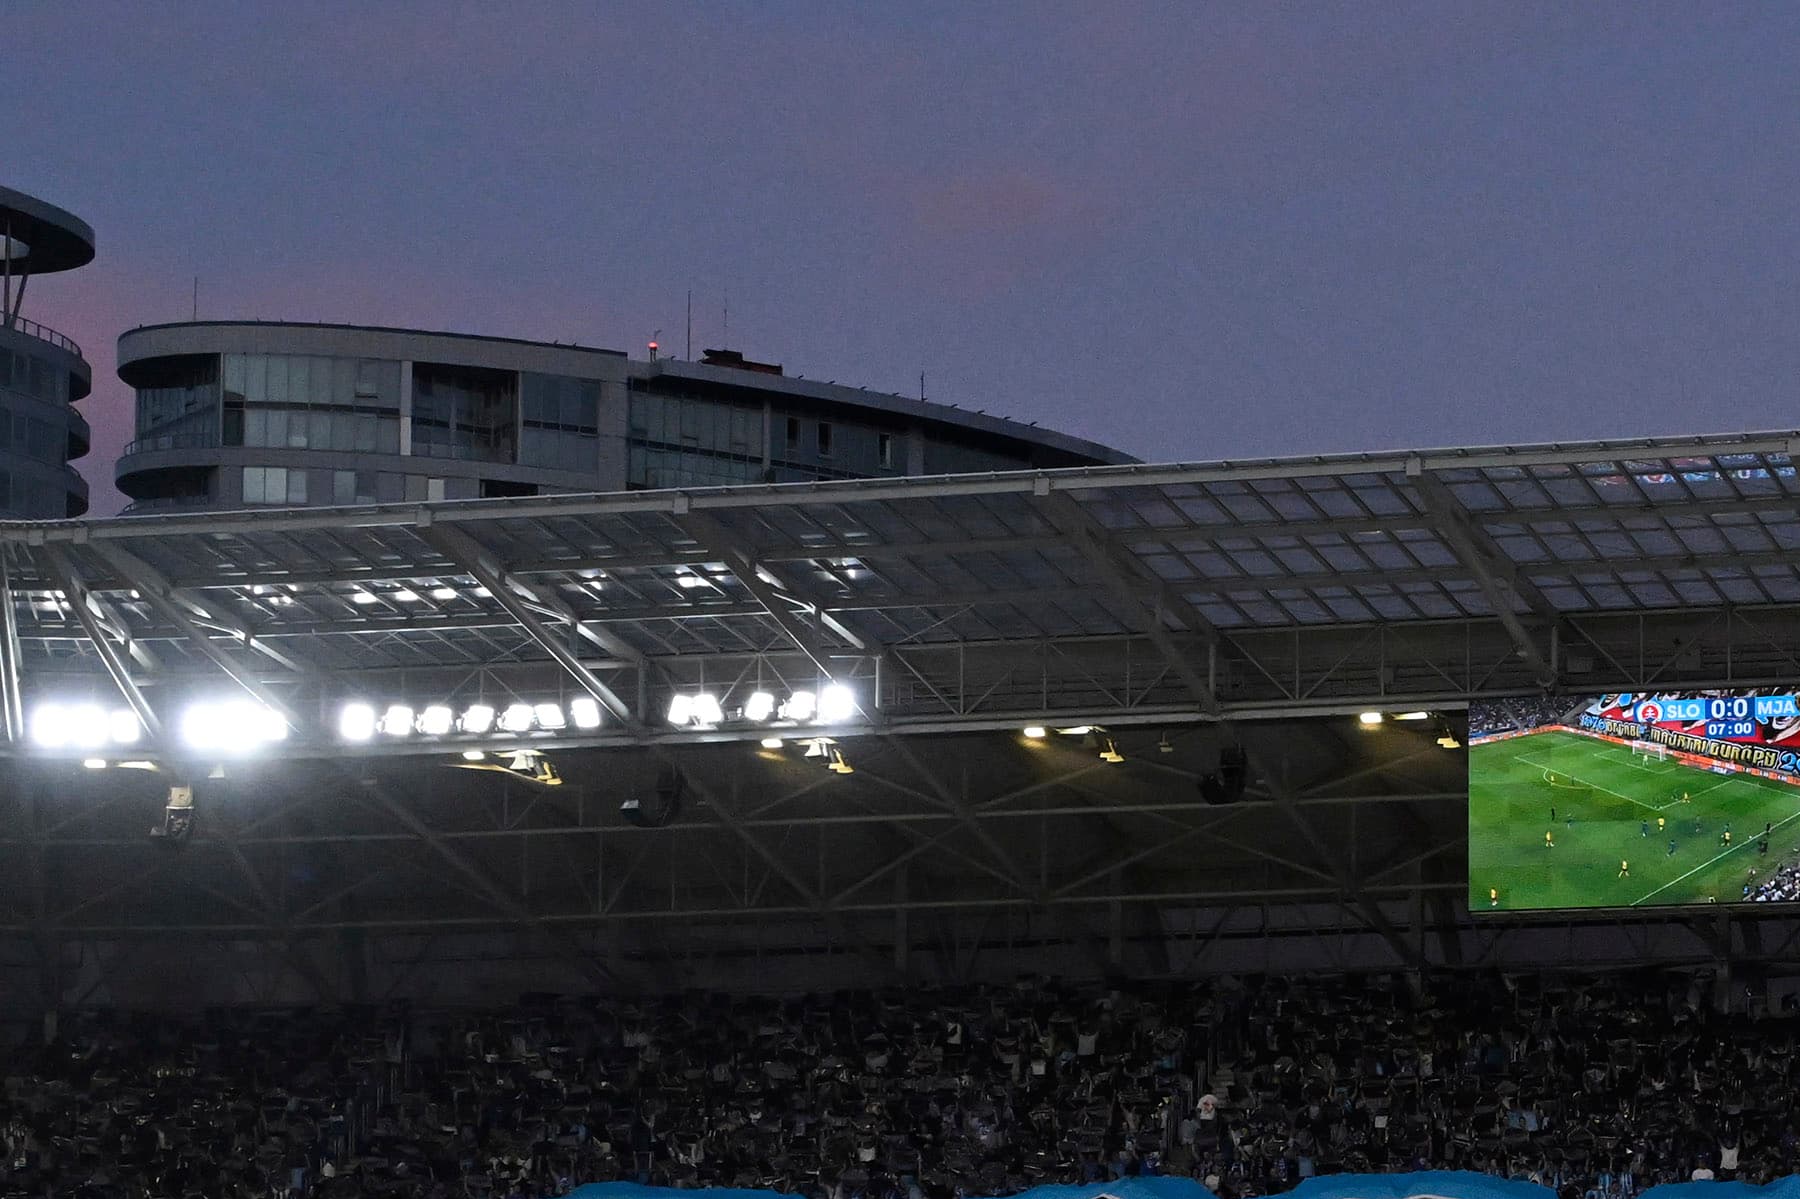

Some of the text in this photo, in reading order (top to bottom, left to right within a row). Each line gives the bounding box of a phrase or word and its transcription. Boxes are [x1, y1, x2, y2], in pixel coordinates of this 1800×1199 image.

[1667, 698, 1796, 719] SLO 0:0 MJA
[1708, 723, 1752, 736] 07:00
